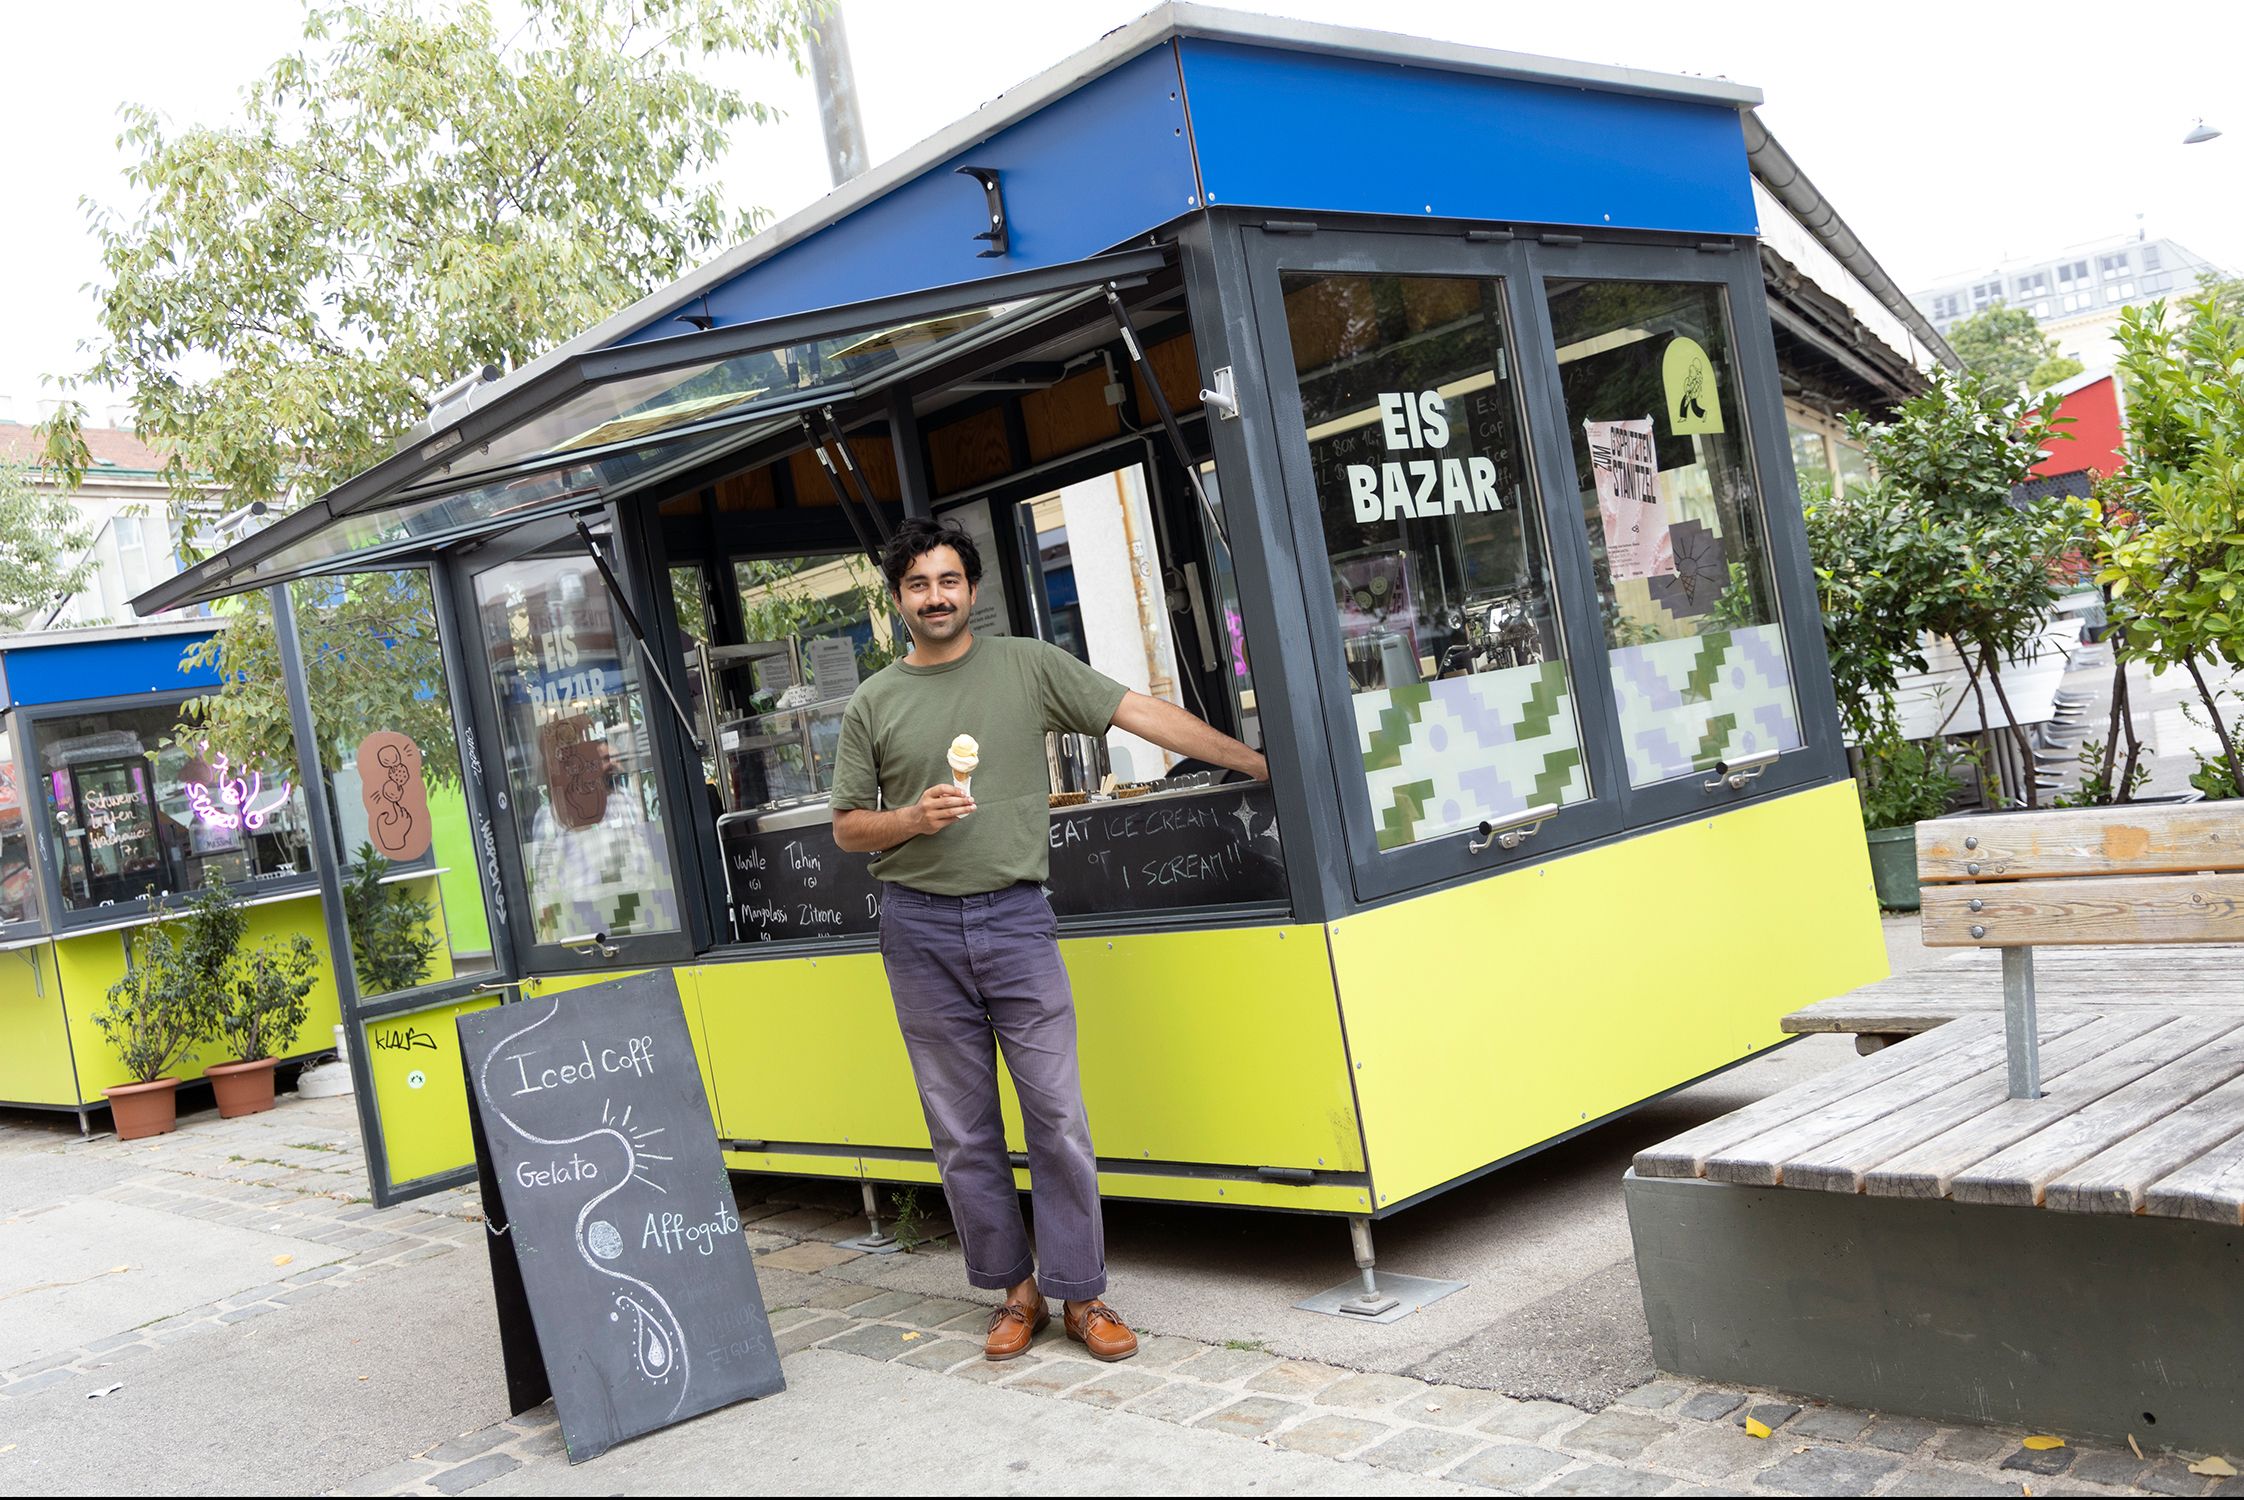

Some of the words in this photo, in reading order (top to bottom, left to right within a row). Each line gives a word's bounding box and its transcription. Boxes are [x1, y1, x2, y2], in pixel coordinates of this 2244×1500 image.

[1378, 390, 1450, 450] EIS
[1592, 444, 1612, 472] ZUM
[1613, 459, 1657, 504] STANITZEL
[1347, 456, 1503, 523] BAZAR
[541, 624, 579, 674] EIS
[530, 667, 609, 727] BAZAR
[1050, 816, 1093, 848] EAT
[1103, 811, 1139, 841] ICE
[1144, 807, 1221, 835] CREAM
[733, 846, 767, 871] Vanille
[784, 841, 821, 871] Tahini
[797, 903, 843, 926] Zitrone
[505, 1039, 597, 1097] Iced
[516, 1152, 598, 1188] Gelato
[641, 1201, 738, 1255] Affogato
